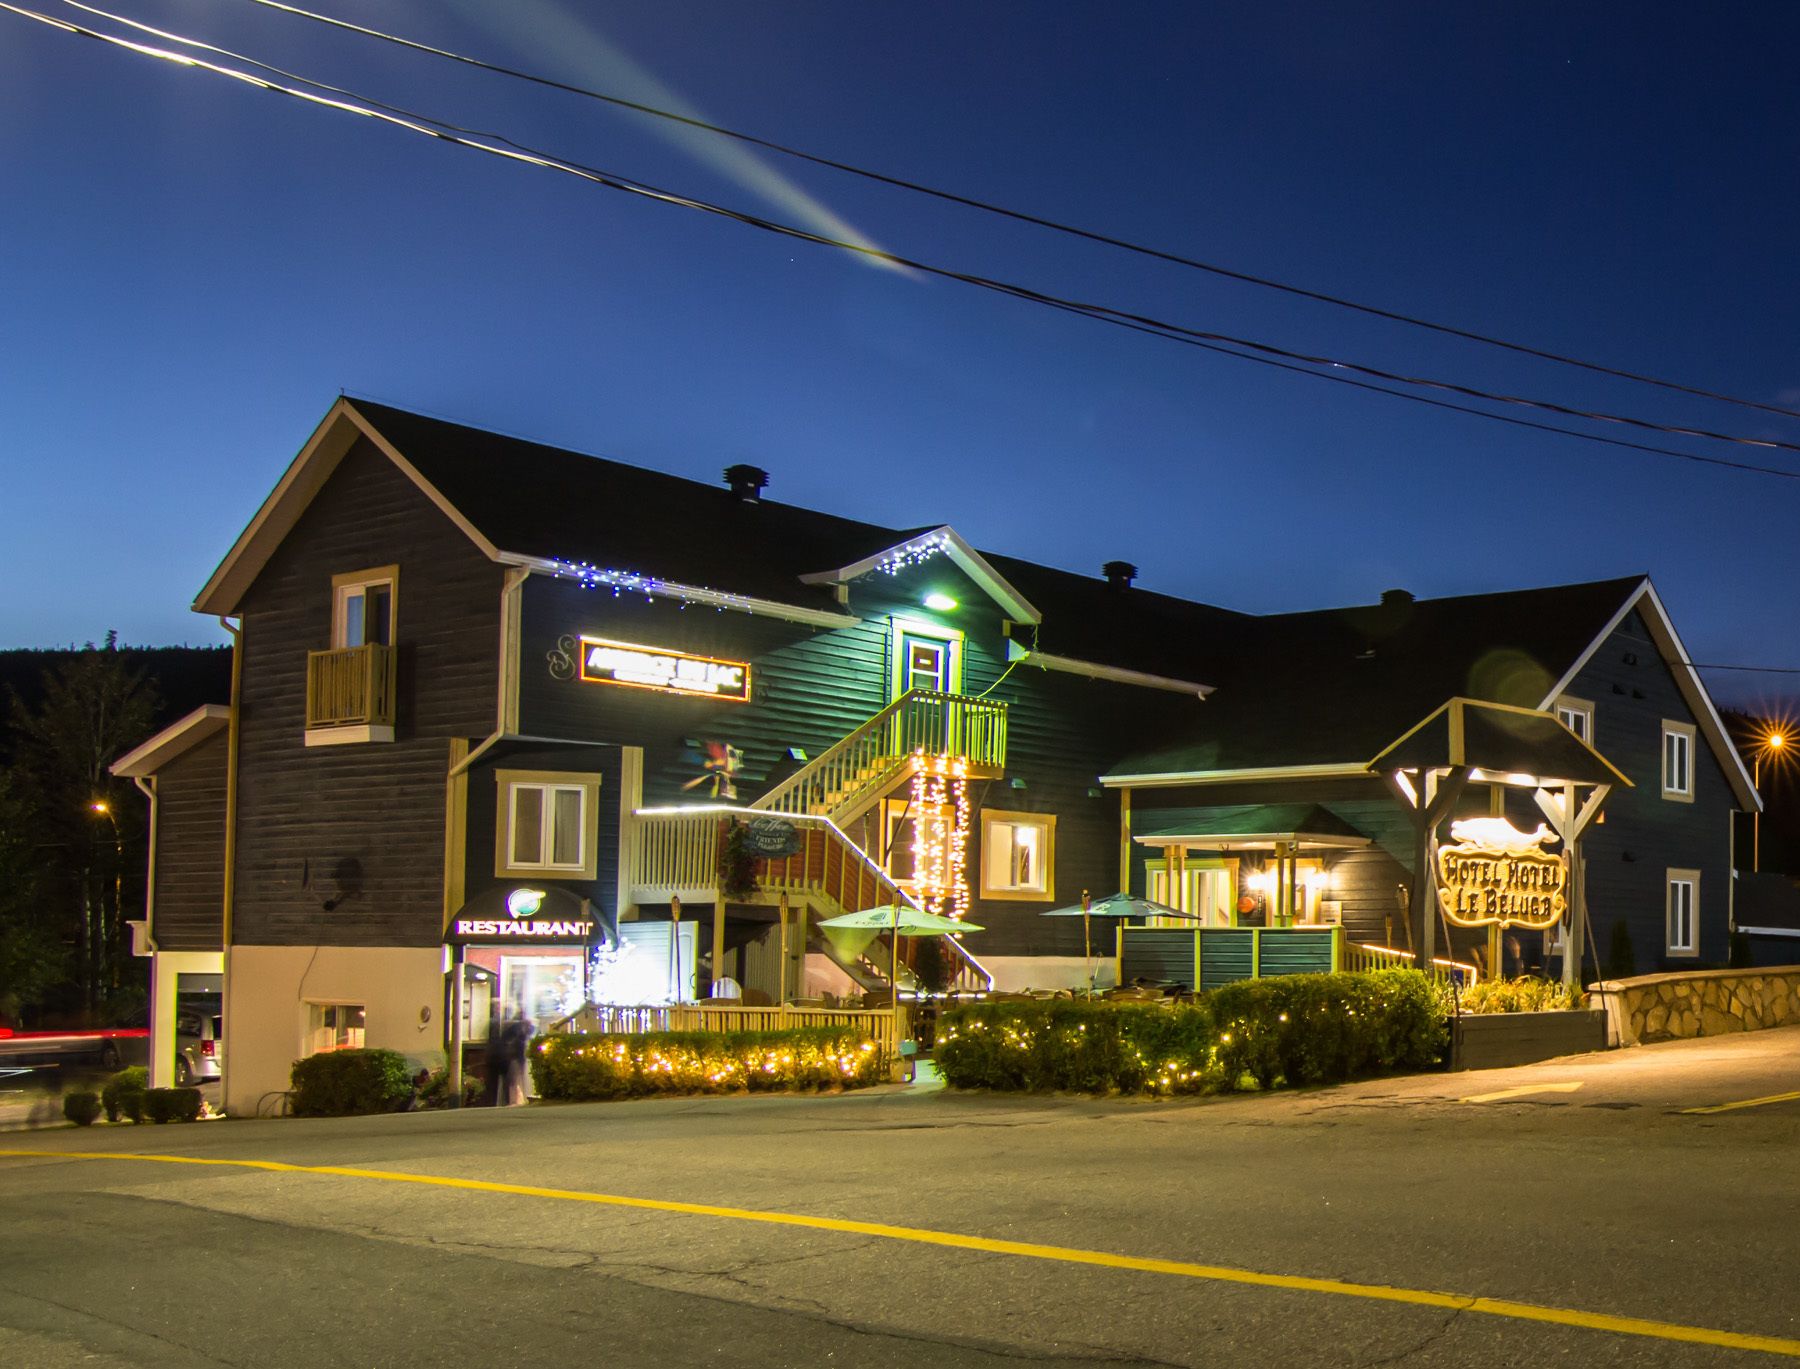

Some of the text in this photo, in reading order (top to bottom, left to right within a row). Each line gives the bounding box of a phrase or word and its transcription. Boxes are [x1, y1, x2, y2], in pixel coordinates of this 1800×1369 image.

[1445, 857, 1559, 886] HOTEL MOTEL
[1457, 888, 1478, 912] LE
[457, 921, 594, 935] RESTAURANT
